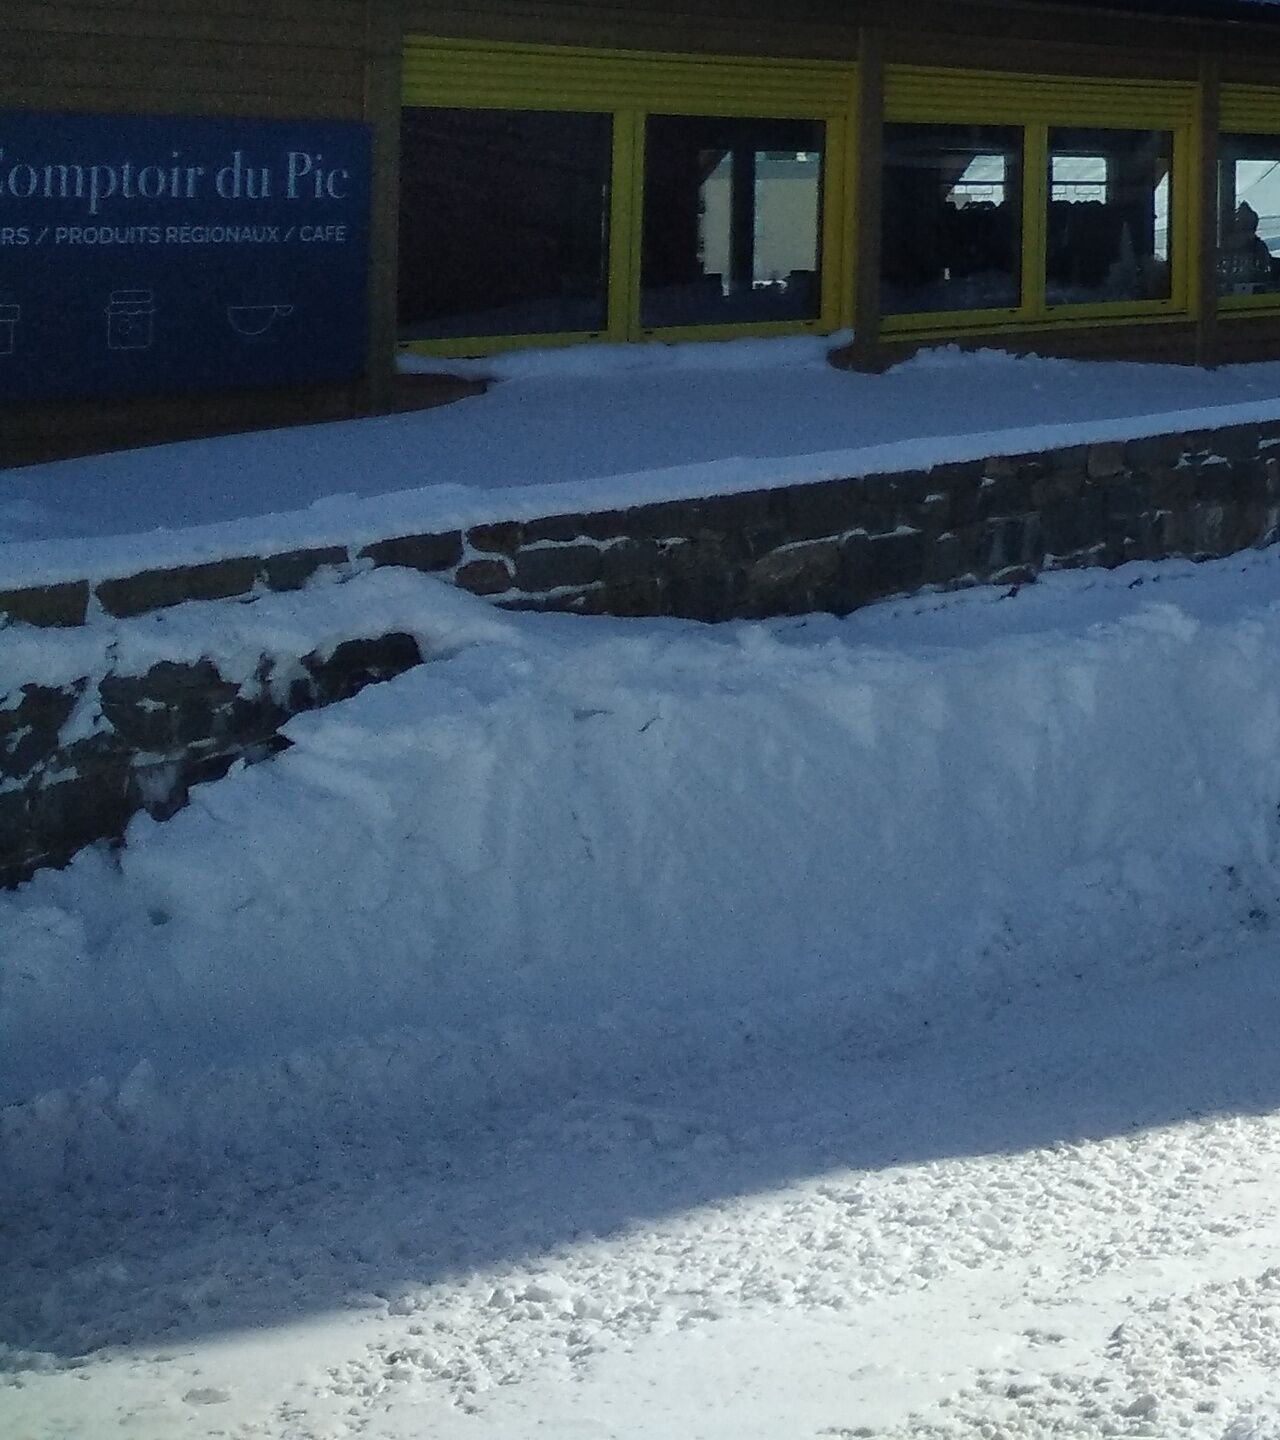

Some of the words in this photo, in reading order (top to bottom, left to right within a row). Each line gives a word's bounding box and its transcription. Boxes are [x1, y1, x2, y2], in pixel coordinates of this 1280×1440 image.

[0, 148, 205, 215] omptoir
[215, 151, 272, 200] du
[286, 151, 350, 200] Pic
[55, 226, 162, 245] PRODUITS
